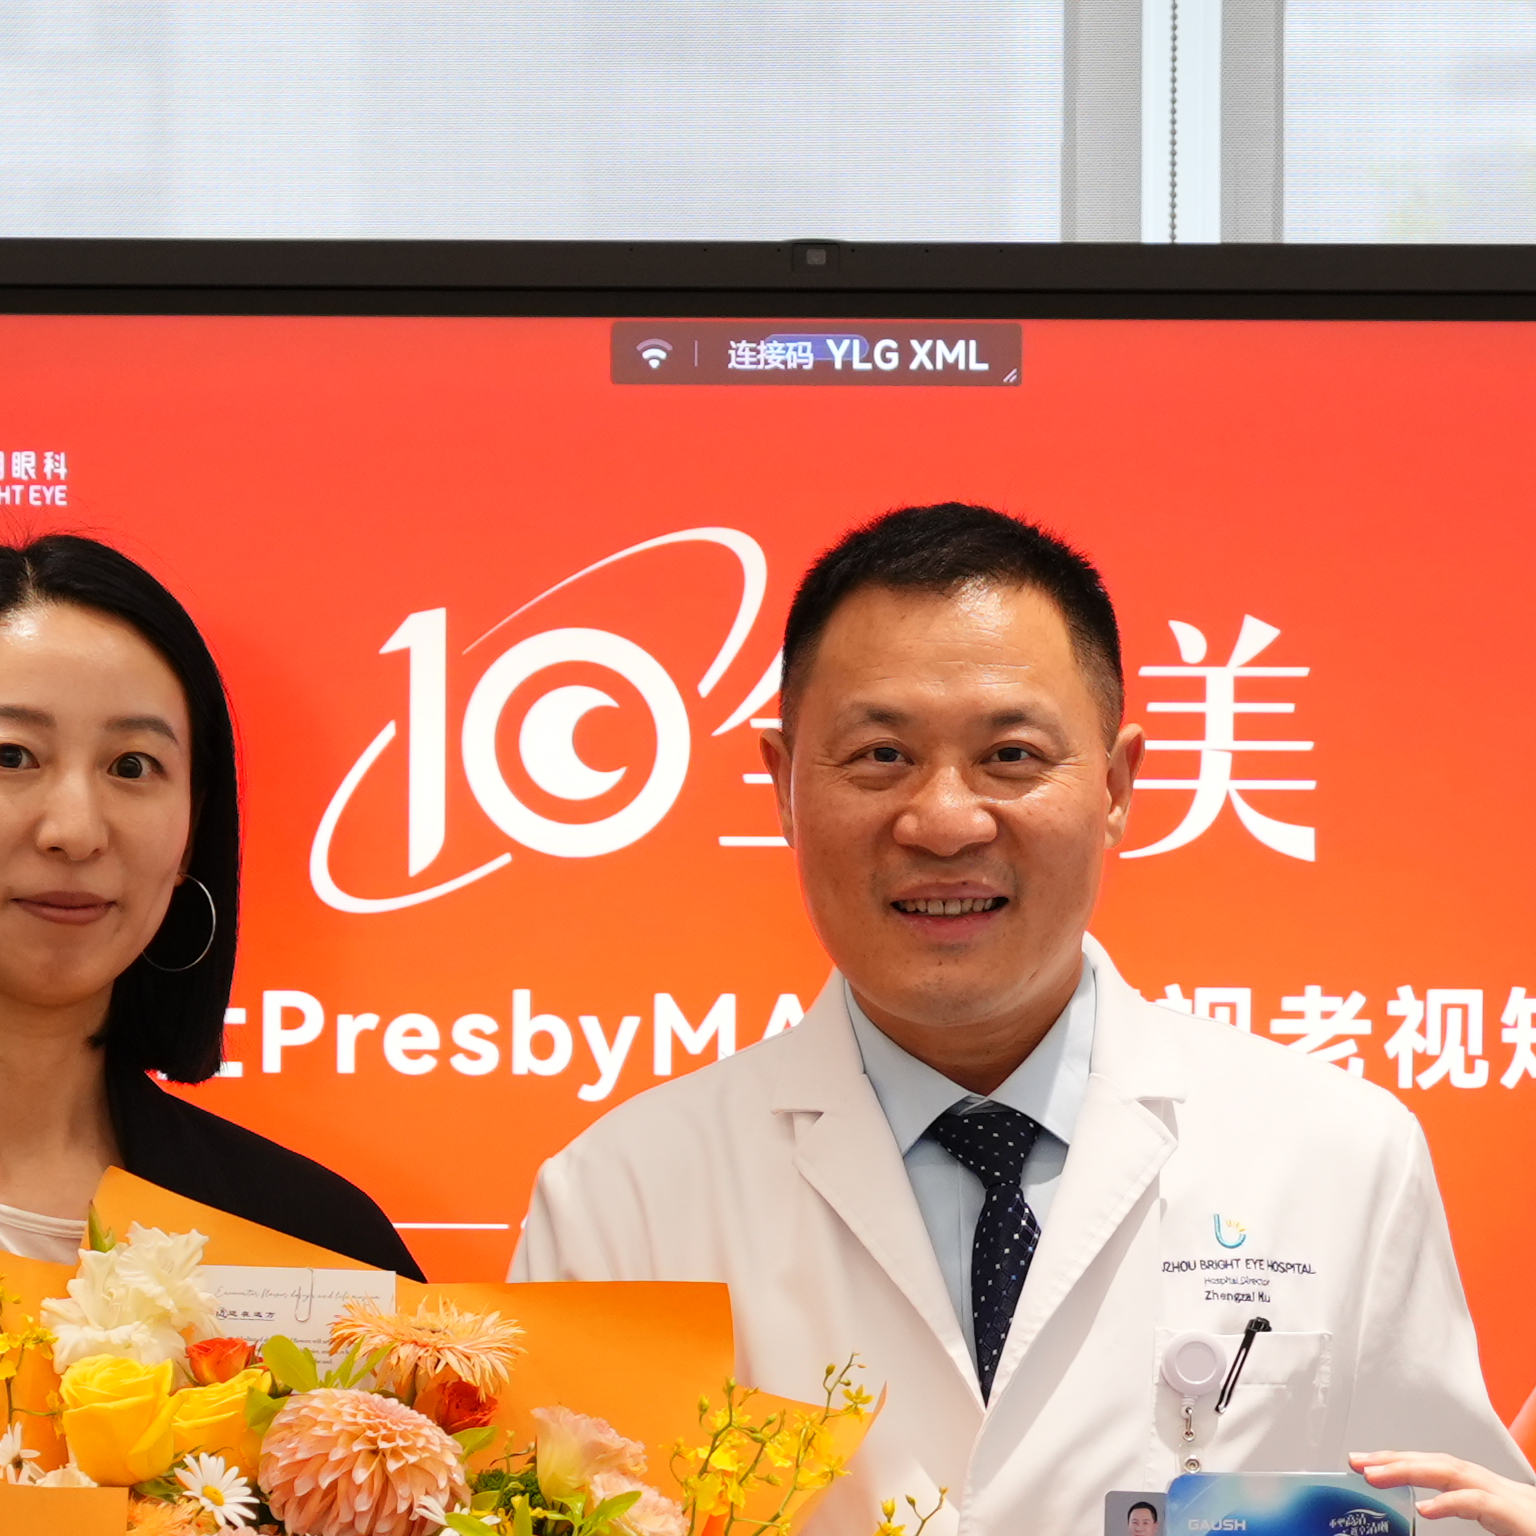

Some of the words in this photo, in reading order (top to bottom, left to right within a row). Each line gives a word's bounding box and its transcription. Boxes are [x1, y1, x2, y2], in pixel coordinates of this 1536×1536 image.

[727, 339, 814, 370] 连接码
[826, 338, 899, 370] YLG
[909, 339, 989, 370] XML
[29, 484, 67, 506] EYE
[1120, 613, 1317, 862] 美
[1199, 1259, 1241, 1271] BRIGHT
[1245, 1258, 1265, 1271] EYE
[1267, 1260, 1316, 1275] HOSPITAL
[1188, 1519, 1246, 1531] GAUSH
